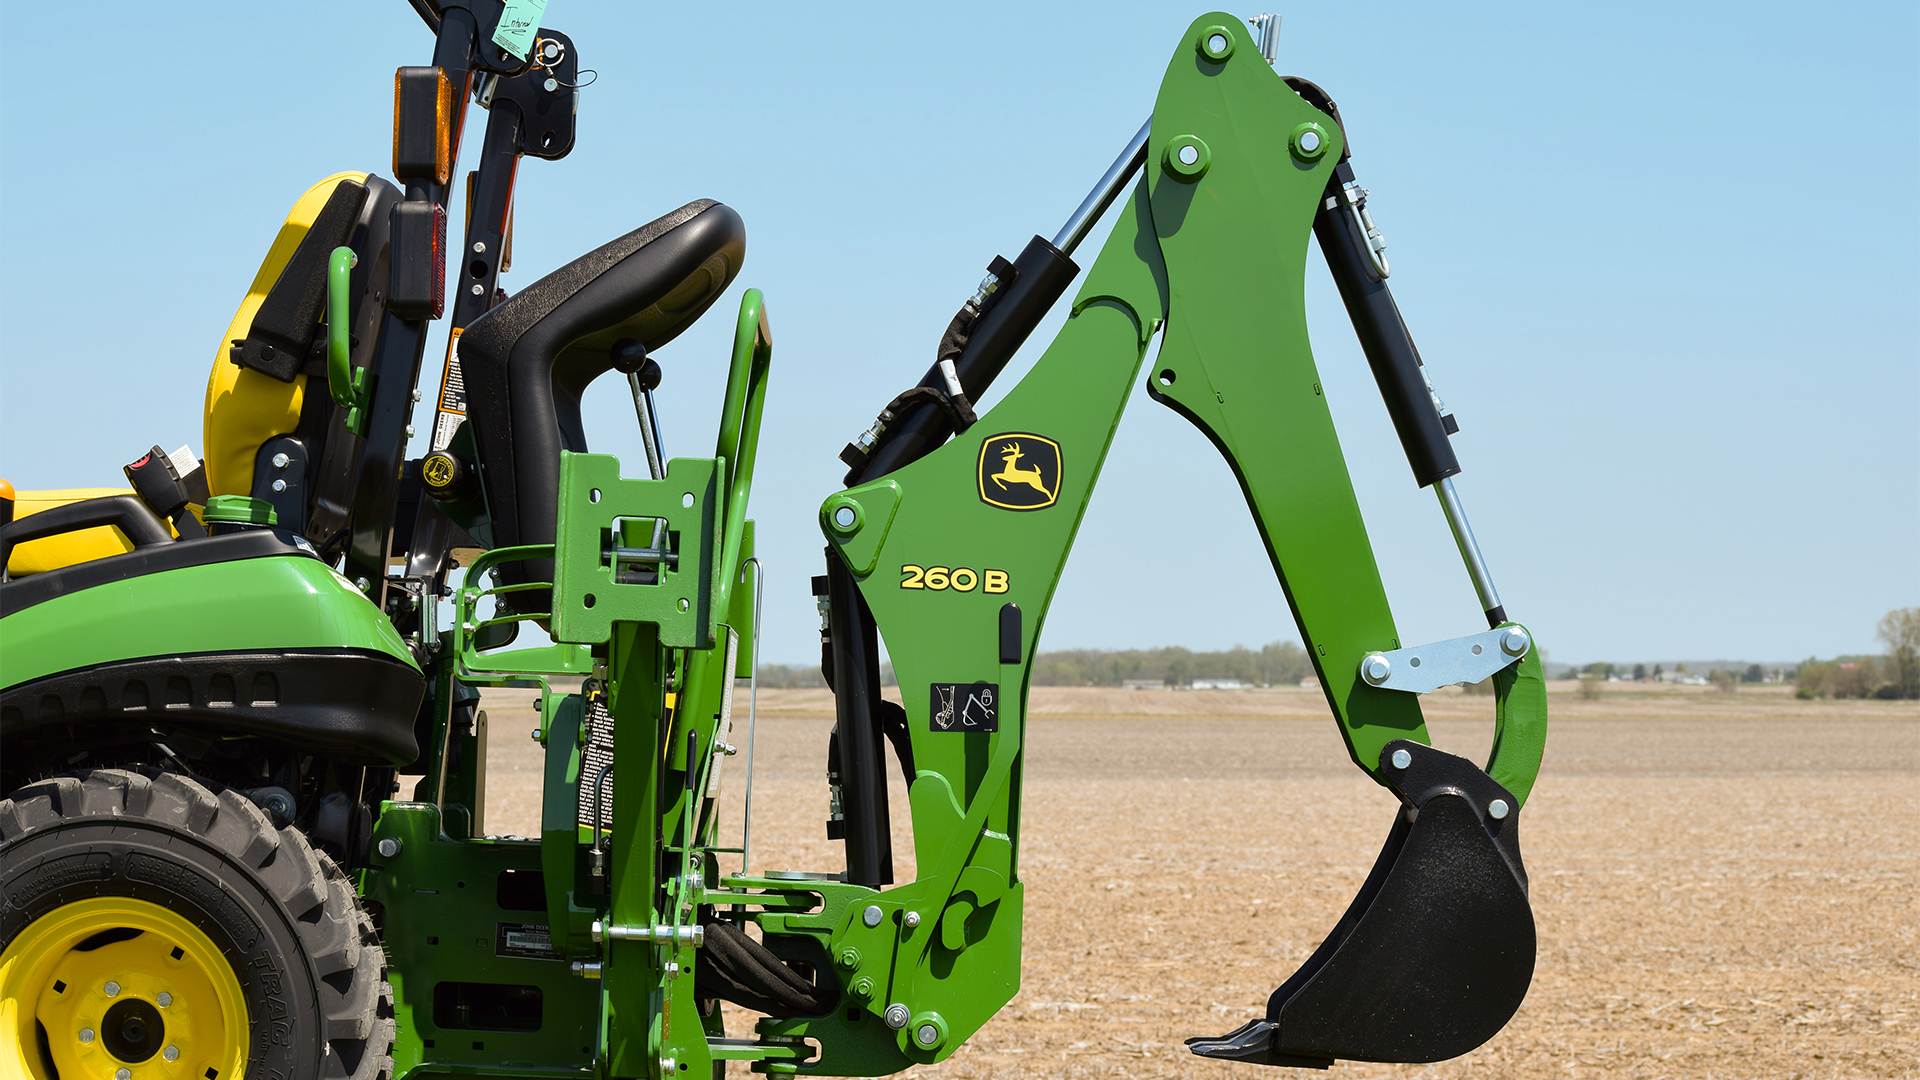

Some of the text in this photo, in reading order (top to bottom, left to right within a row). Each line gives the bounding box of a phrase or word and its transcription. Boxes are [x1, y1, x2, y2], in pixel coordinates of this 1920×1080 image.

[900, 564, 1010, 595] 260 B
[254, 948, 289, 1047] TRAC
